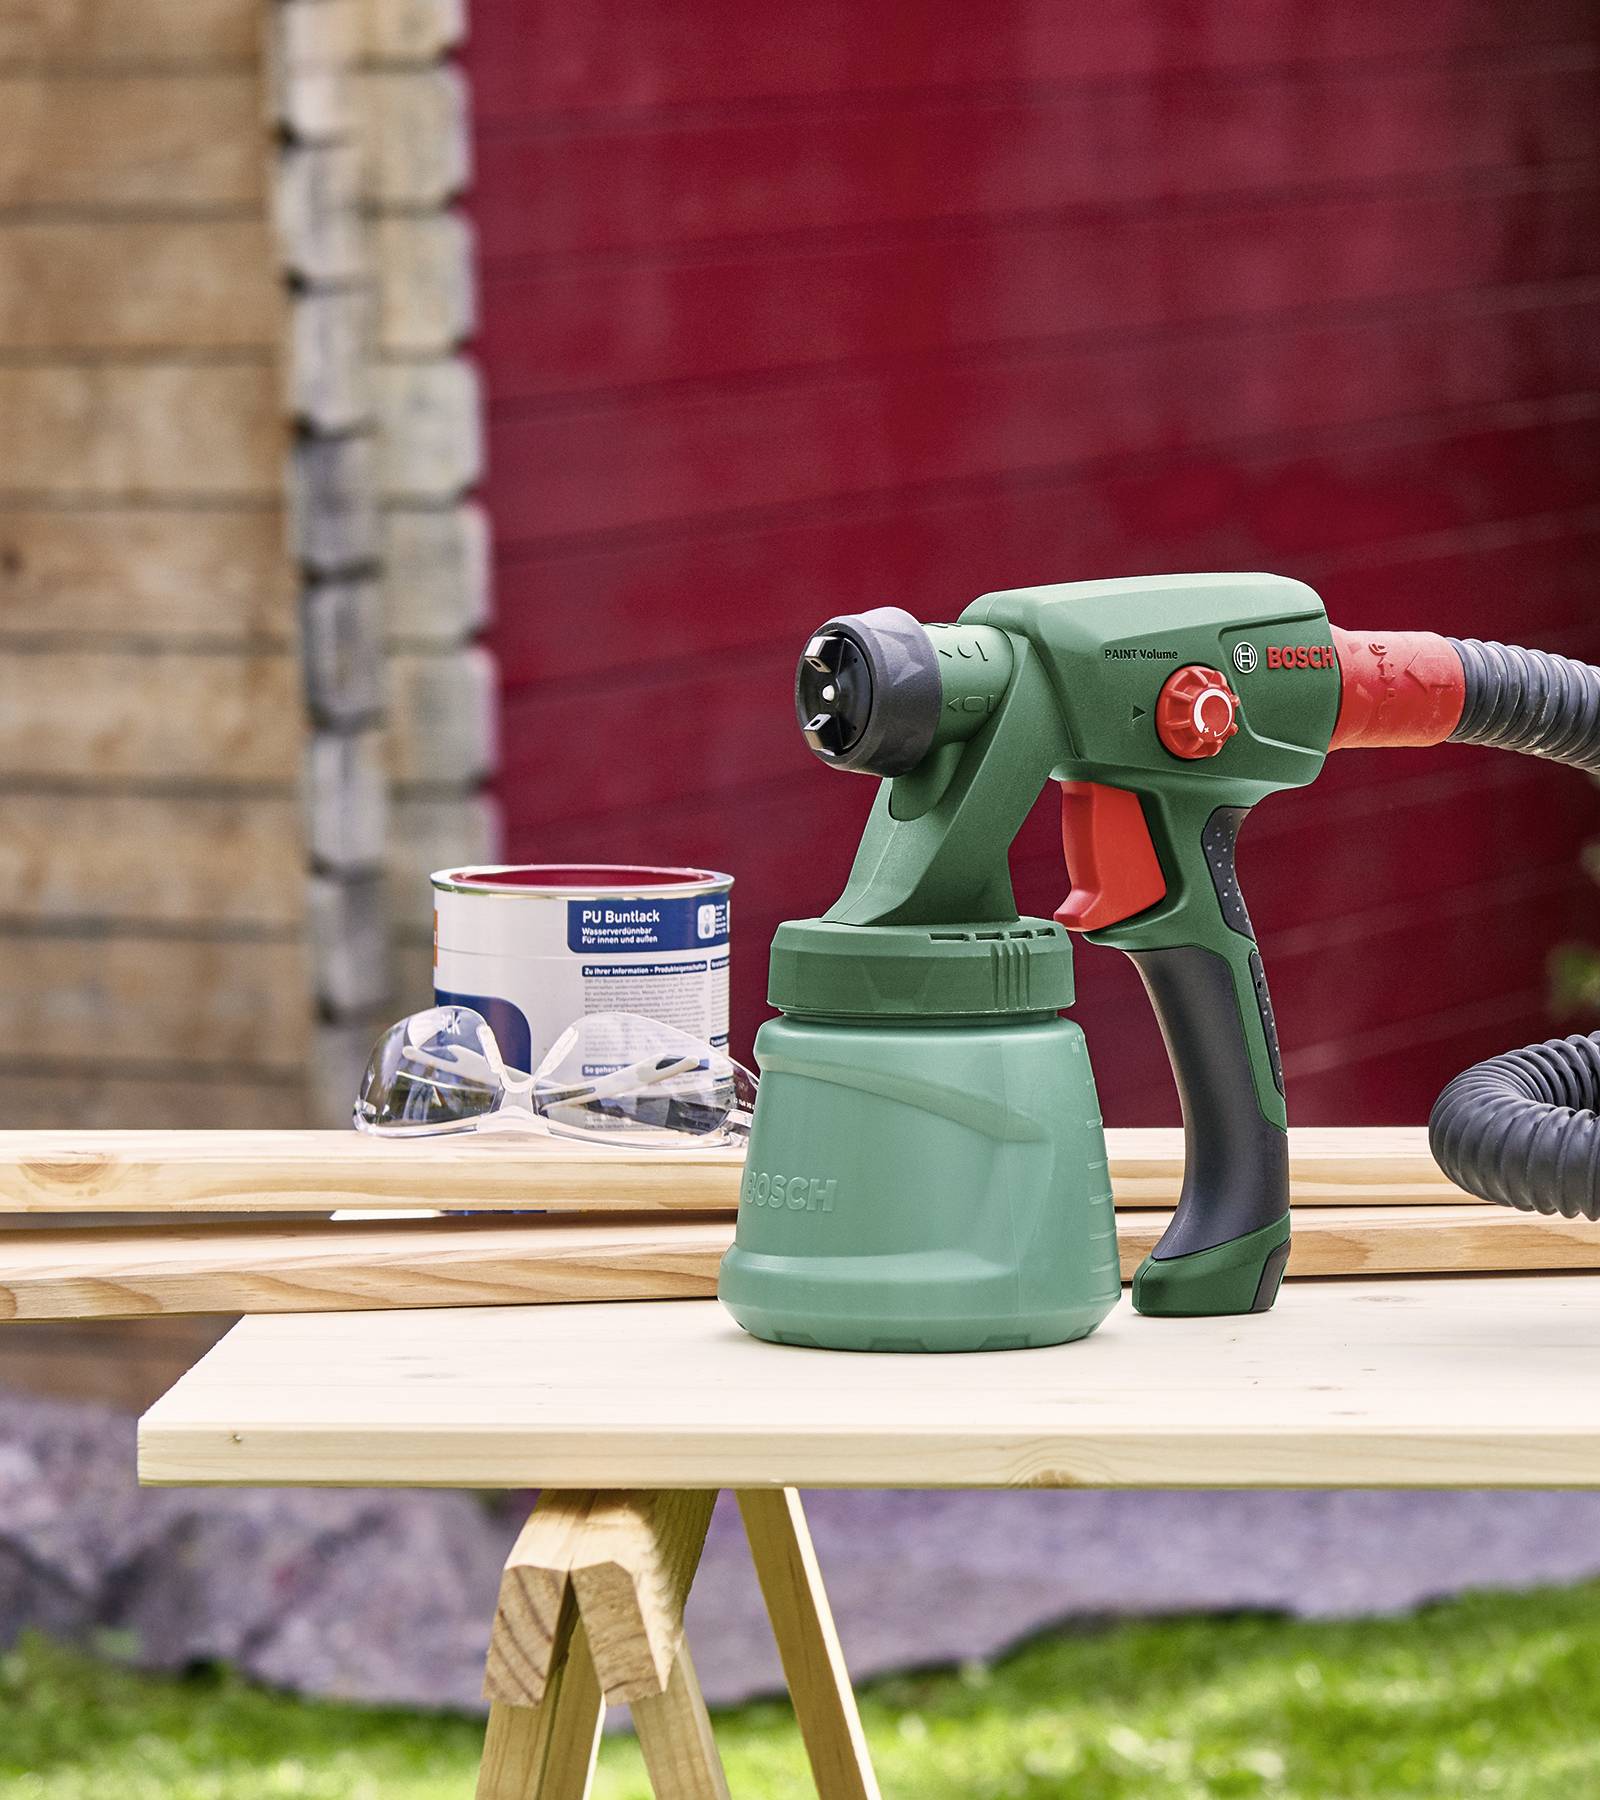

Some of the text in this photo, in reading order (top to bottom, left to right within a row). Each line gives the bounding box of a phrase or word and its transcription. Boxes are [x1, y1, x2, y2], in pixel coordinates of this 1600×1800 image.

[1104, 648, 1178, 661] PAINT Volume
[1266, 646, 1335, 670] BOSCH
[582, 909, 660, 924] PU Buntlack
[582, 927, 652, 936] Wasserverdünnbar
[582, 935, 658, 944] Für innen und außen
[584, 967, 593, 975] Zu
[612, 966, 649, 975] Information
[584, 1066, 593, 1074] So
[743, 1171, 838, 1212] BOSCH
